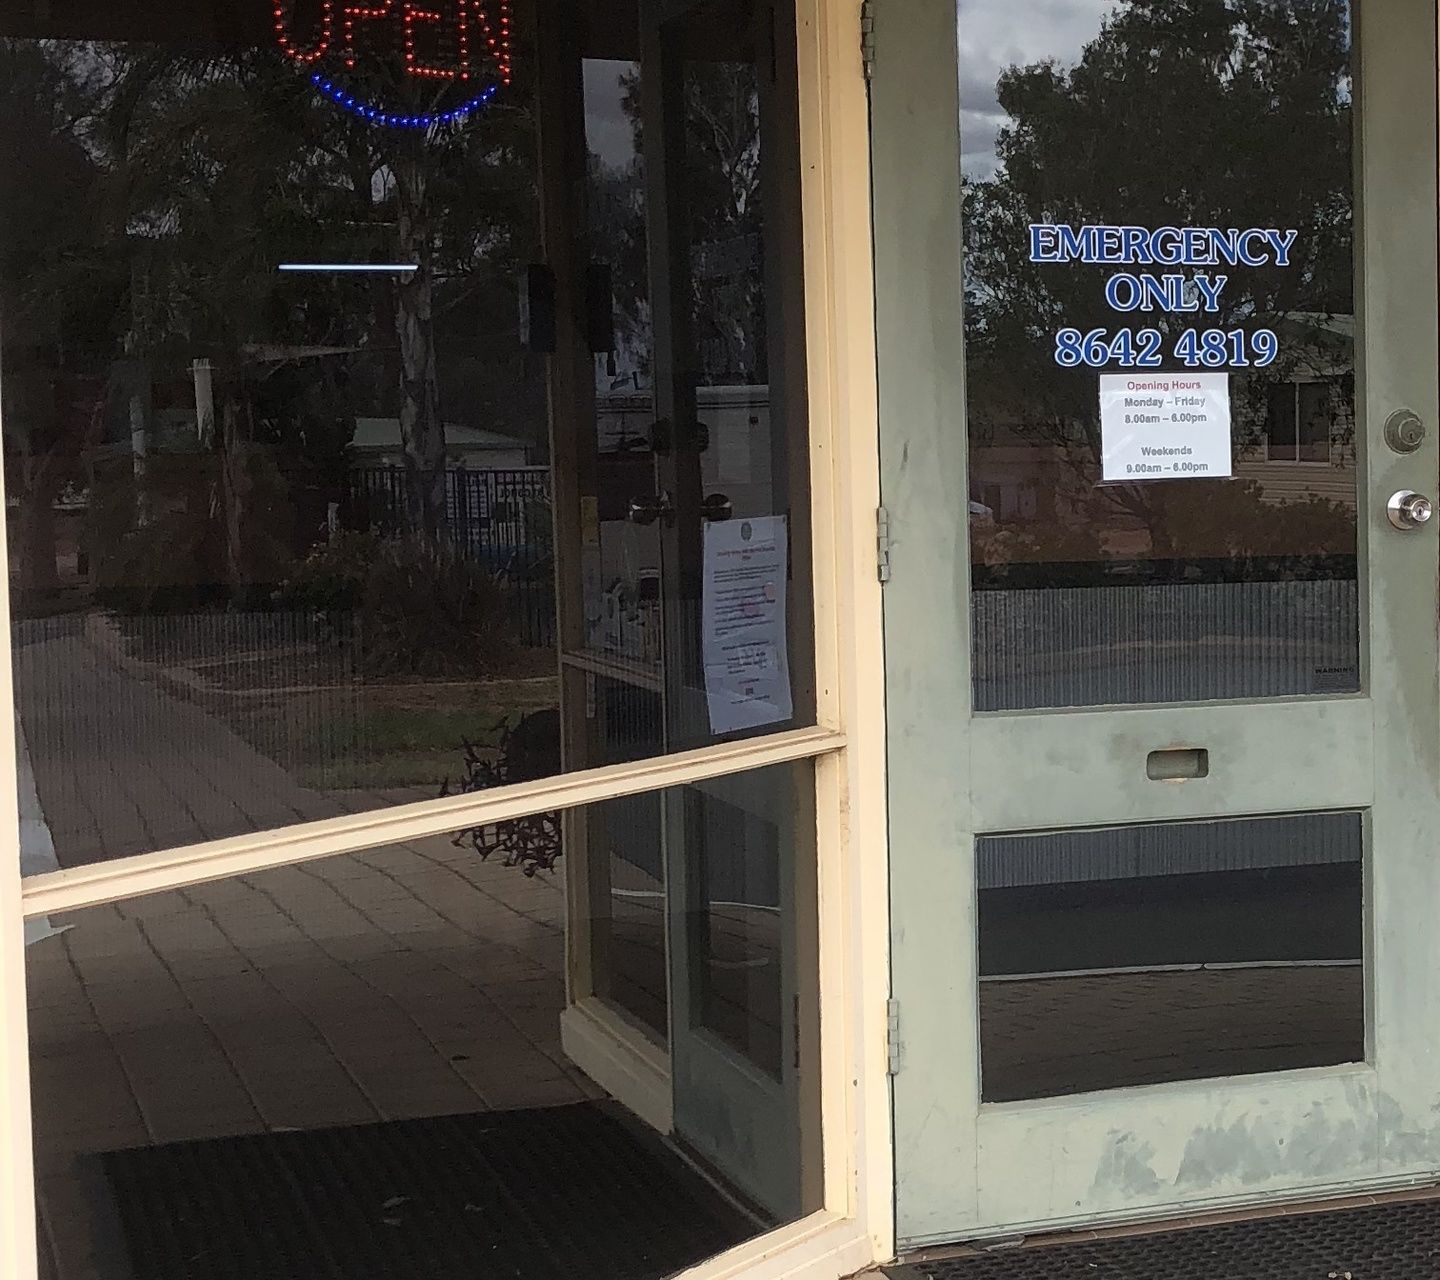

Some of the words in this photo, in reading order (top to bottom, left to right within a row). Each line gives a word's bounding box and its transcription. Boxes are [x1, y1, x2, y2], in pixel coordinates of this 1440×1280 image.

[1028, 224, 1298, 267] EMERGENCY
[1105, 272, 1228, 313] ONLY
[1054, 327, 1163, 367] 8642
[1173, 327, 1279, 367] 4819
[1127, 381, 1169, 392] Opening
[1172, 380, 1201, 390] Hours
[1124, 397, 1164, 408] Monday
[1174, 396, 1206, 408] Friday
[1124, 414, 1160, 424] 8.00am
[1141, 445, 1193, 456] Weekends
[1126, 464, 1162, 474] 9.00am
